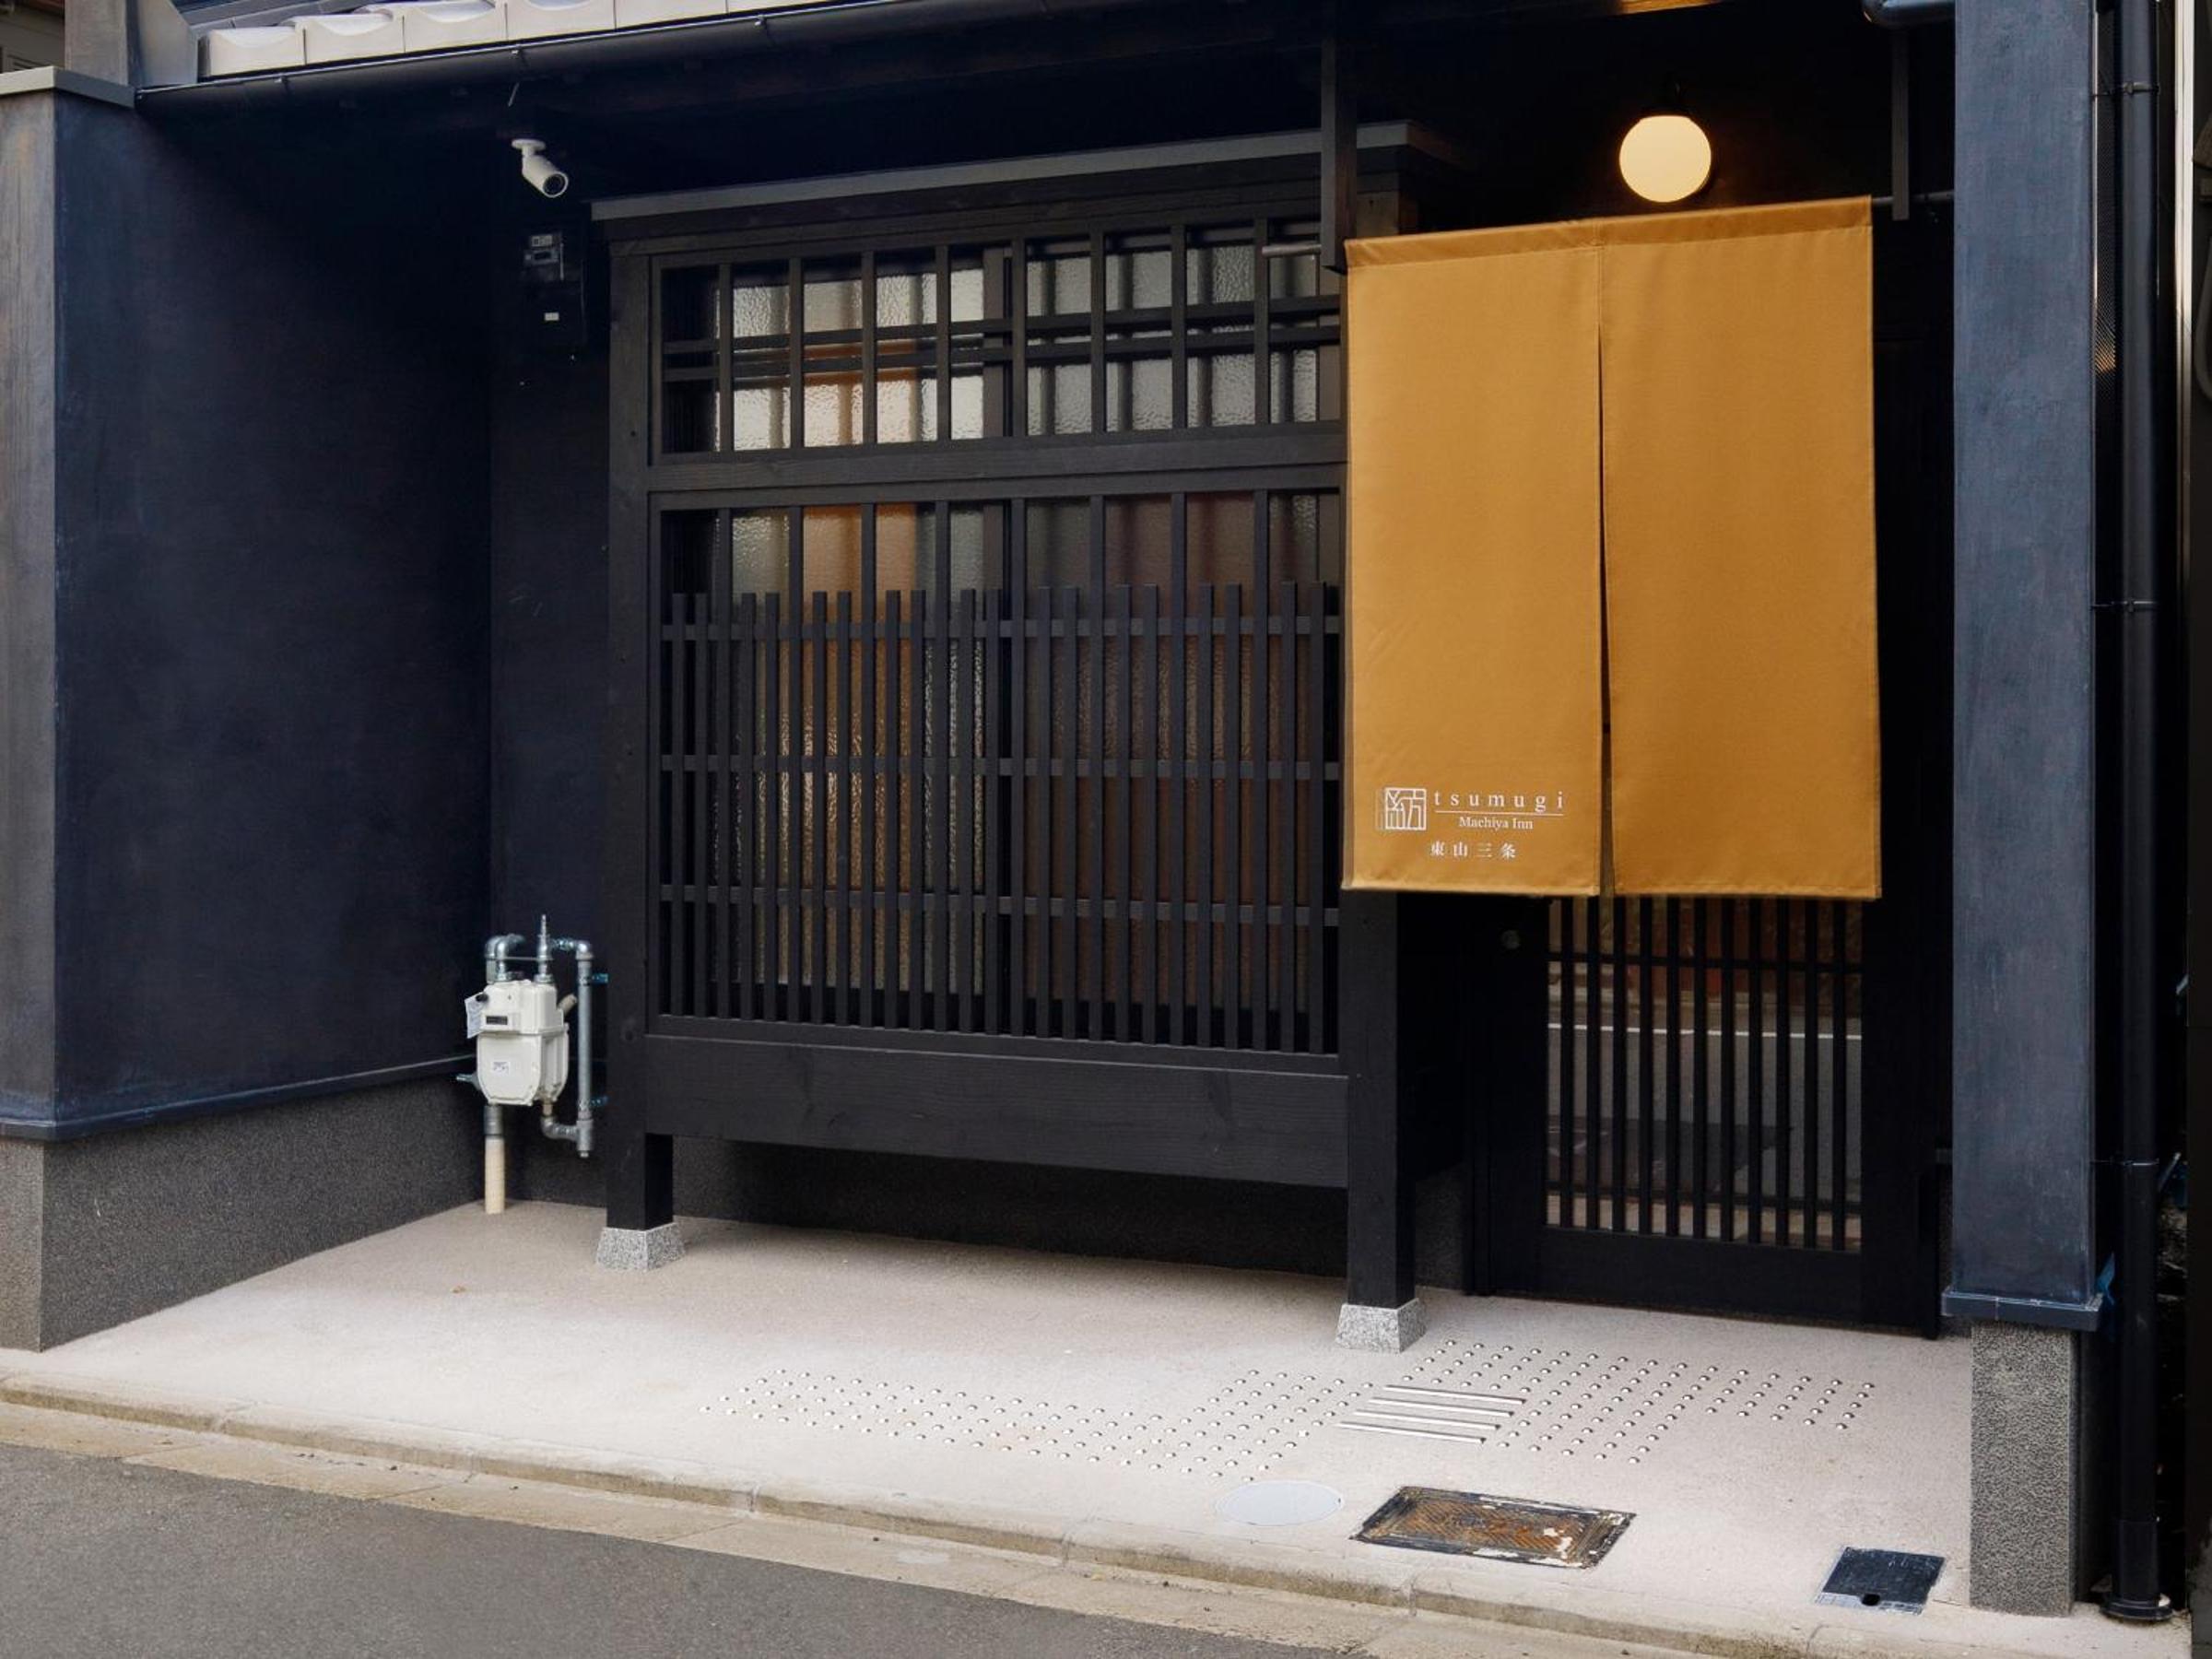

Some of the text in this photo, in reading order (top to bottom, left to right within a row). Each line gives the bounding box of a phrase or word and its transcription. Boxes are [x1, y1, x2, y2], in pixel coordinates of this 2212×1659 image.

[1434, 791, 1563, 812] tsumugi
[1459, 816, 1534, 830] Machiya Inn
[1430, 841, 1516, 859] 東山三条
